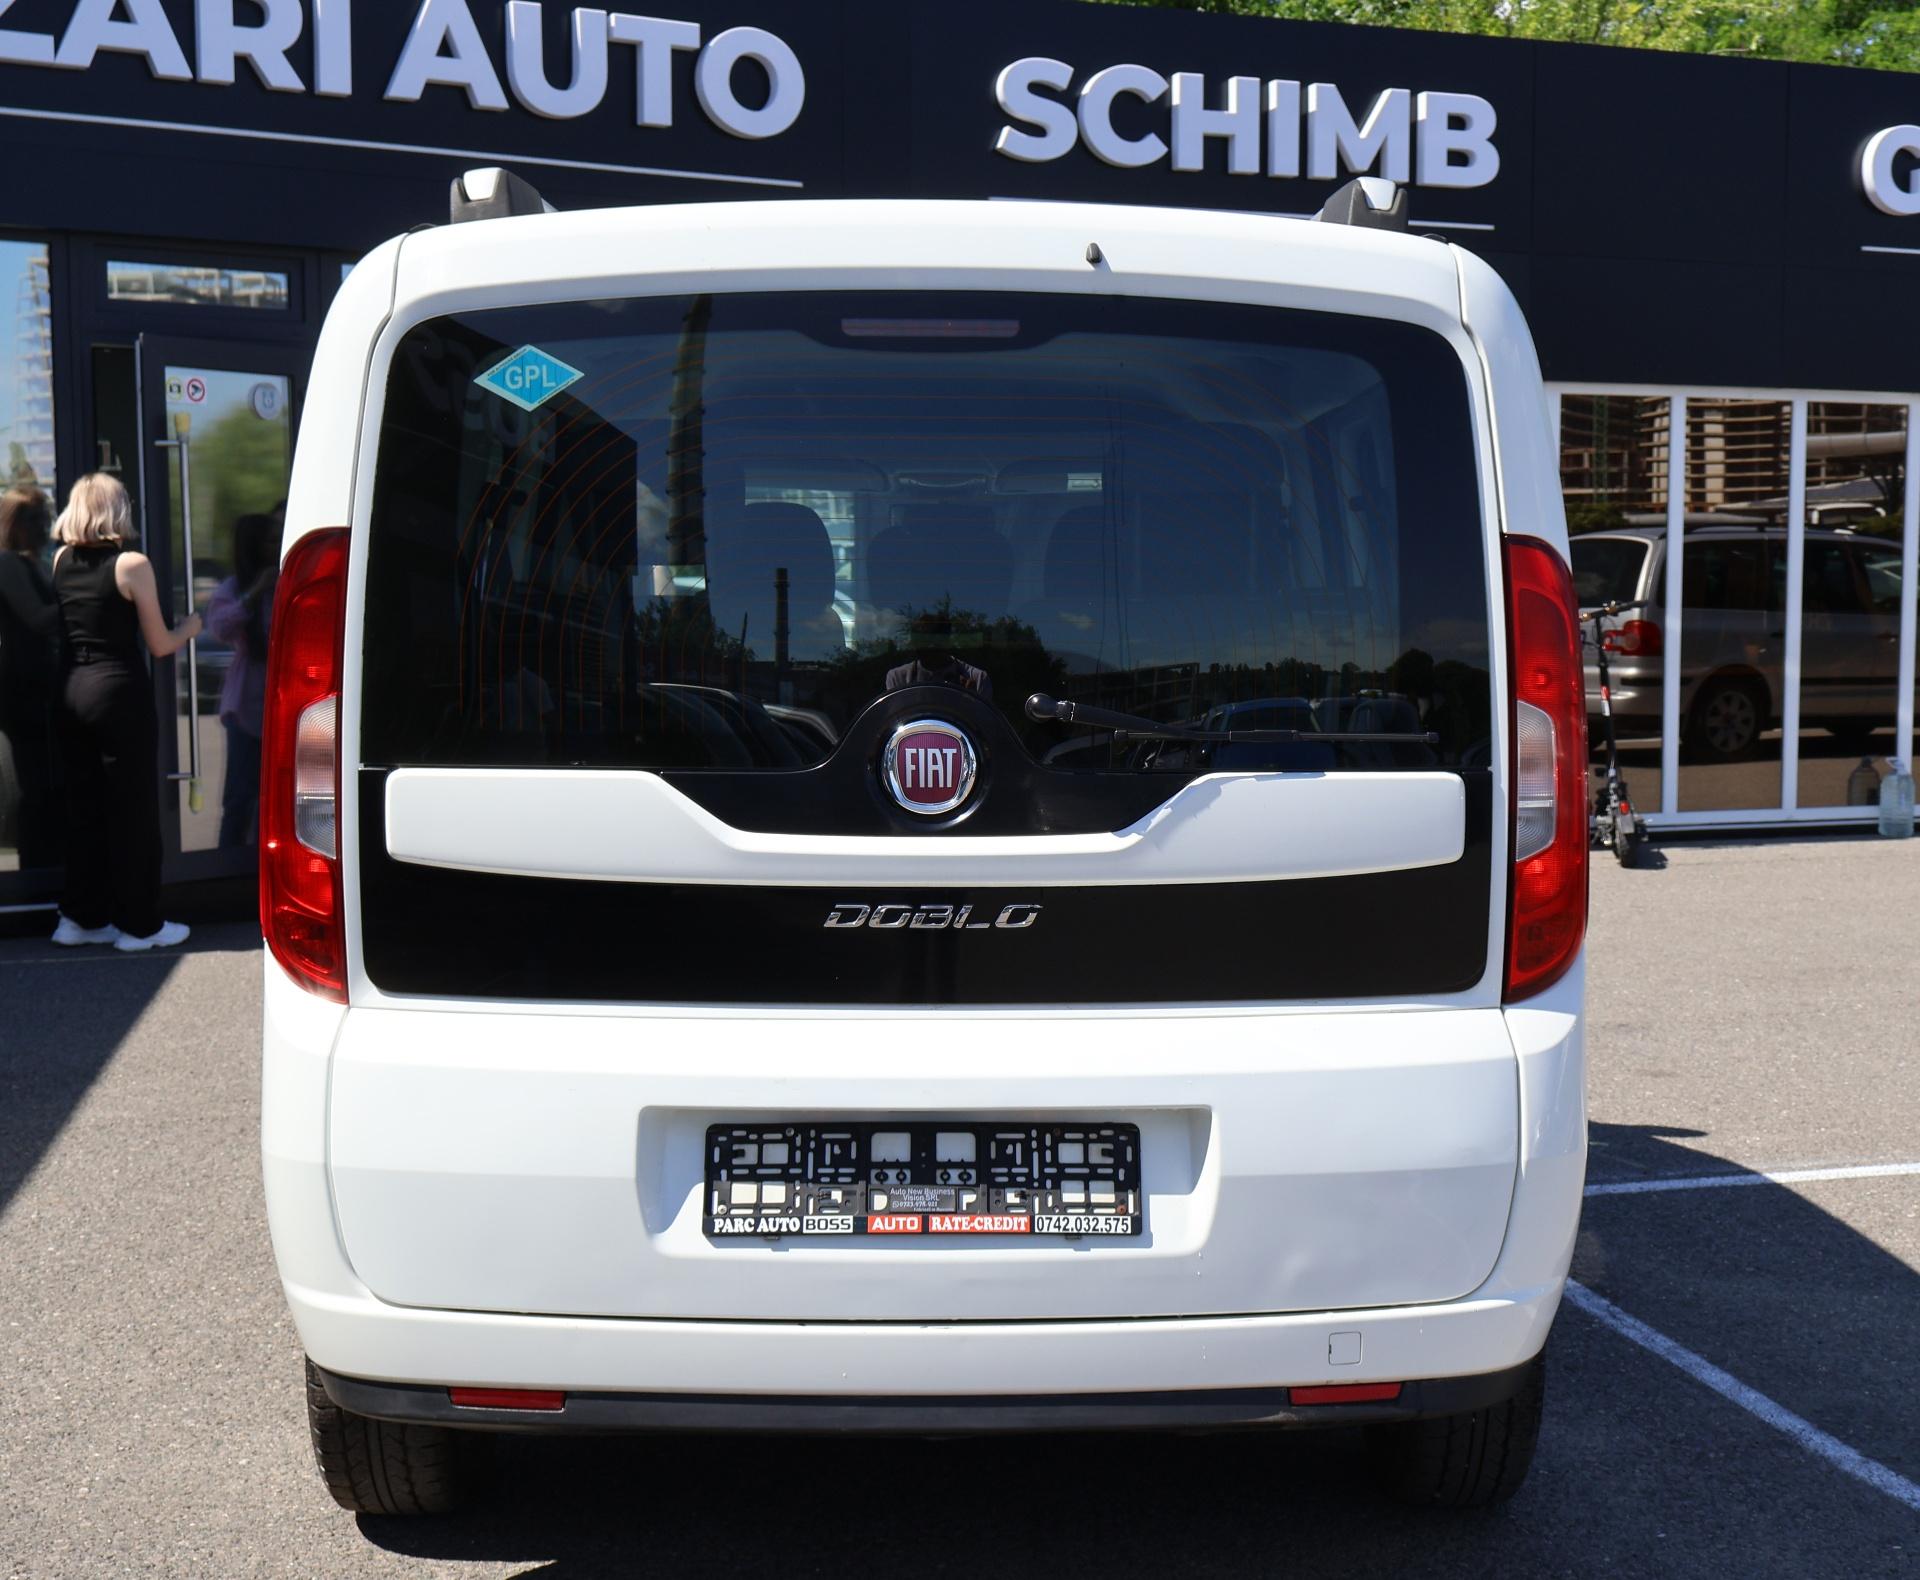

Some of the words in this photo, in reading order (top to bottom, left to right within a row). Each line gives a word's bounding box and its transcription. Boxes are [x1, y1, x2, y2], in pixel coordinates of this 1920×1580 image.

[383, 0, 805, 140] AUTO
[995, 56, 1500, 188] SCHIMB
[504, 364, 557, 390] GPL
[904, 748, 957, 789] FIAT
[890, 1187, 906, 1195] Auto
[907, 1187, 923, 1195] New
[924, 1187, 956, 1196] Business
[902, 1194, 925, 1202] Vision
[713, 1217, 755, 1233] PARC
[756, 1217, 801, 1233] AUTO
[805, 1218, 851, 1231] BOSS
[871, 1217, 919, 1231] AUTO
[931, 1216, 1028, 1232] RATE-CREDIT
[1036, 1216, 1130, 1233] 0742.032.575
